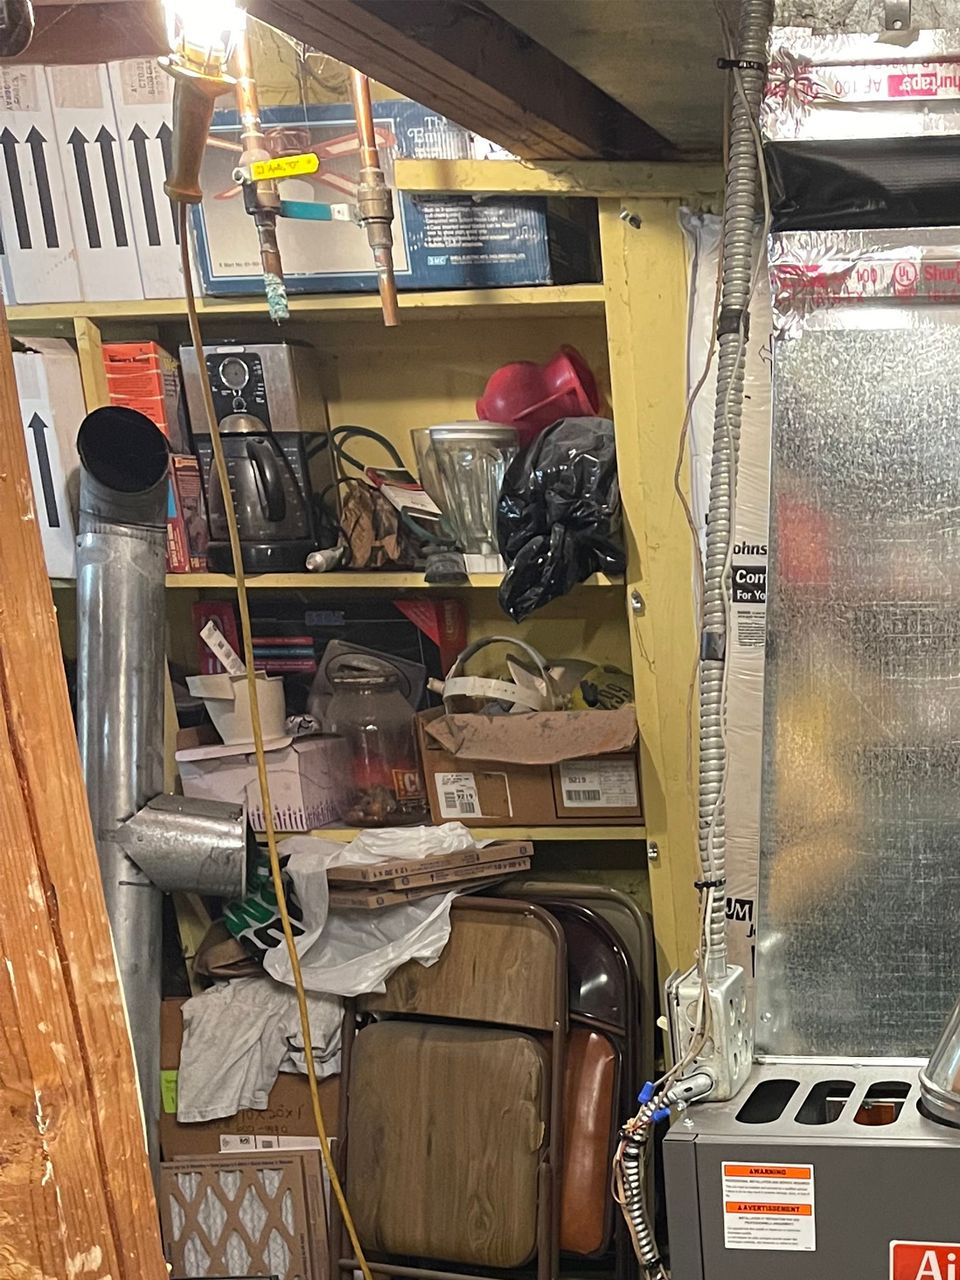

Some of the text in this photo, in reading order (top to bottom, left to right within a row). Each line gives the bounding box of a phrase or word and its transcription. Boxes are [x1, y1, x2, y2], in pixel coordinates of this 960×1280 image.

[736, 589, 752, 600] For
[753, 1168, 787, 1176] WARNING
[743, 1204, 801, 1213] AVERTISSEMENT
